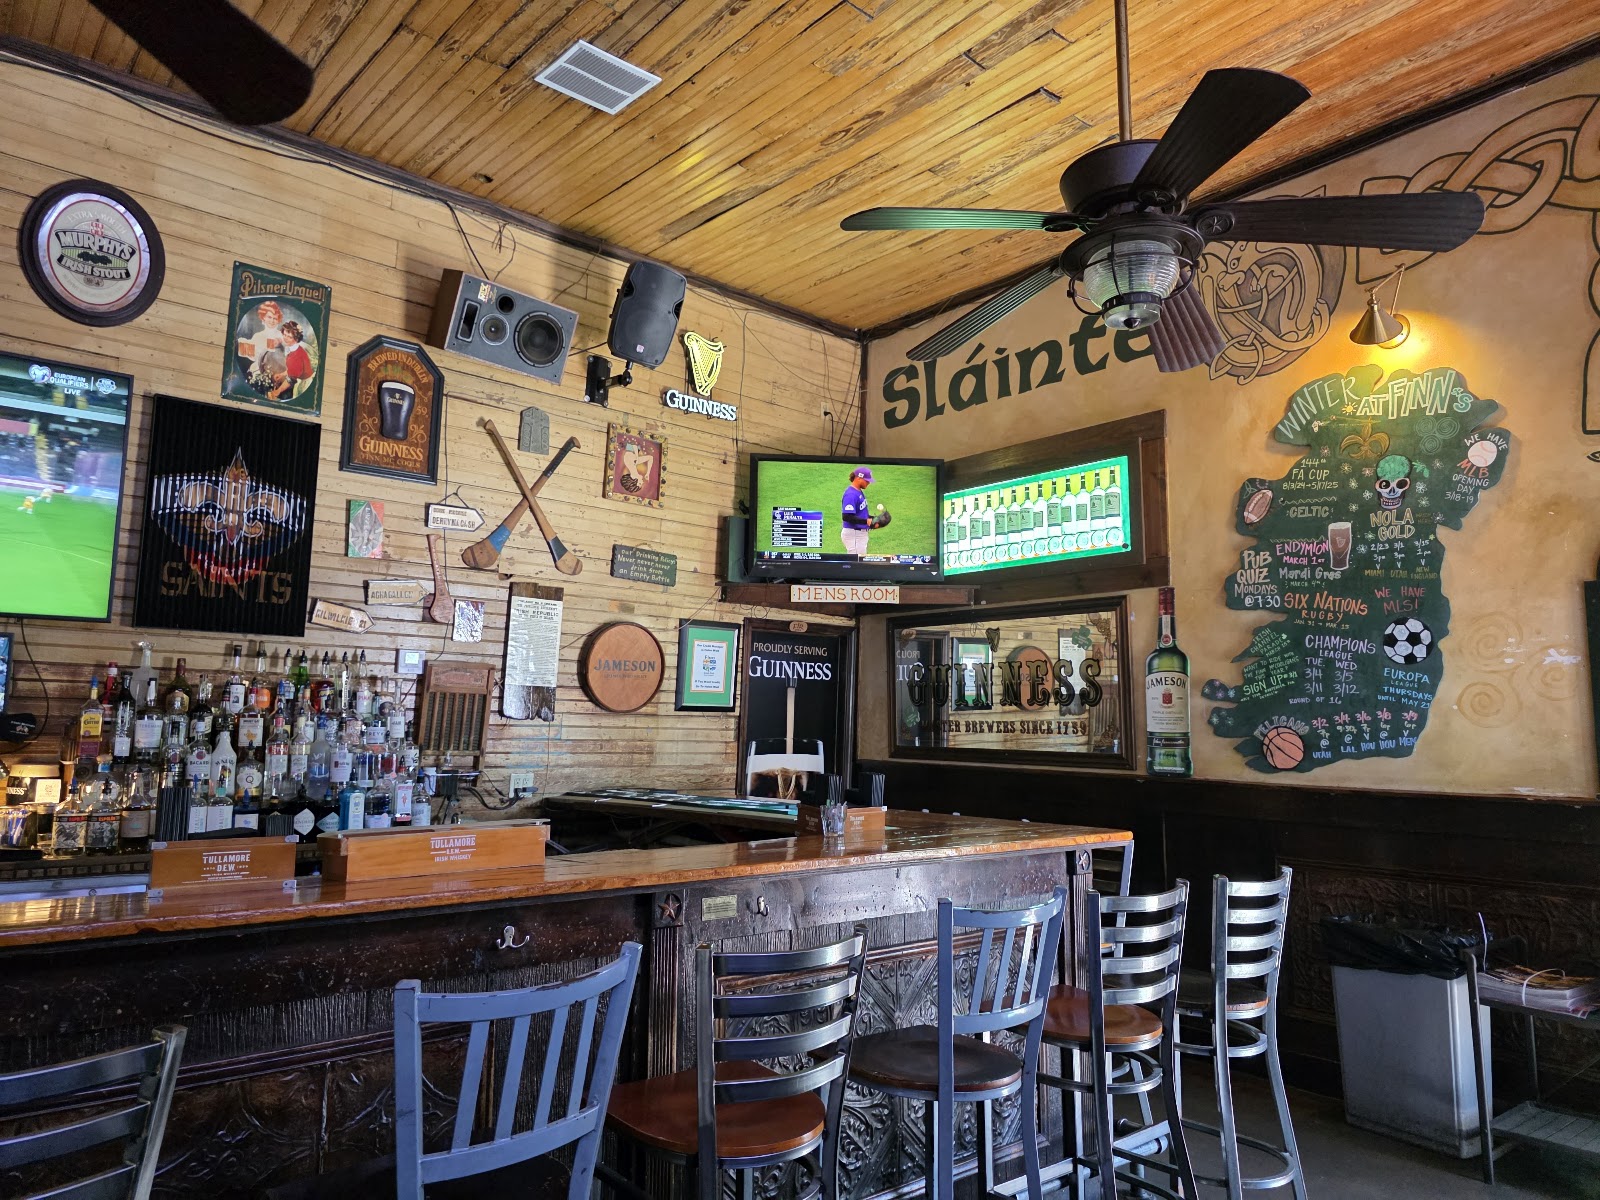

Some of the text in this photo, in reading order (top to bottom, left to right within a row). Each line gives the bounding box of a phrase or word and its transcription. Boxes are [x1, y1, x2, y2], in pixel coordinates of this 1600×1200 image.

[60, 257, 127, 279] IRISH STOUT
[239, 272, 325, 303] Pilsner Urquell
[367, 352, 429, 384] BREWED IN DUBLIN
[49, 377, 89, 388] QUALIFIERS
[54, 372, 86, 382] EUROPEAN
[362, 395, 372, 406] 17
[666, 389, 737, 421] GUINNESS
[1277, 376, 1360, 439] WINTER
[1356, 394, 1389, 416] AT
[360, 436, 424, 461] GUINNESS
[1464, 433, 1508, 451] WE HAVE
[1292, 469, 1330, 480] FA CUP
[1457, 459, 1489, 478] MLB
[1453, 474, 1490, 487] OPENING
[1457, 484, 1475, 495] DAY
[1289, 506, 1329, 518] CELTIC
[1370, 508, 1414, 527] NOLA
[1378, 525, 1415, 541] GOLD
[1276, 540, 1329, 556] ENDYMION
[1371, 543, 1390, 552] 2/23
[1394, 541, 1405, 551] 3/1
[636, 551, 659, 562] Drinking
[1242, 550, 1272, 570] PUB
[1283, 556, 1308, 565] MARCH
[630, 571, 650, 580] Empty
[1236, 568, 1271, 584] QUIZ
[1279, 567, 1341, 580] Mardi Gras
[1365, 569, 1385, 577] MIAMI
[161, 561, 292, 605] SAINTS
[797, 587, 897, 601] MENS ROOM
[1234, 584, 1278, 598] MONDAYS
[1375, 586, 1425, 598] WE HAVE
[1284, 591, 1368, 615] SIX NATIONS
[1384, 598, 1418, 615] MLS!
[1301, 610, 1343, 623] RUGBY
[1250, 632, 1279, 653] CHANNEL
[1253, 627, 1272, 644] IRISH
[753, 642, 828, 656] PROUDLY SERVING
[1260, 637, 1282, 654] PARADE
[1305, 634, 1376, 654] CHAMPIONS
[1320, 650, 1353, 660] LEAGUE
[594, 659, 657, 672] JAMESON
[749, 656, 832, 681] GUINNESS
[907, 658, 1104, 707] GUINNESS
[1305, 667, 1353, 683] 3/4 3/5
[1384, 667, 1430, 684] EUROPA
[1146, 676, 1187, 690] JAMESON
[1243, 679, 1267, 695] SIGN
[1270, 674, 1283, 687] UP
[1305, 682, 1359, 697] 3/11 3/12
[1383, 686, 1433, 700] THURSDAYS
[1401, 697, 1419, 707] MAY
[964, 720, 1016, 733] BREWERS
[1019, 720, 1054, 734] SINCE
[1056, 721, 1087, 735] 1759
[1254, 716, 1310, 740] PELICANS
[1312, 717, 1329, 729] 3/2
[1320, 731, 1388, 748] @ @ @
[431, 837, 476, 849] TULLAMORE
[203, 854, 251, 864] TULLAMORE
